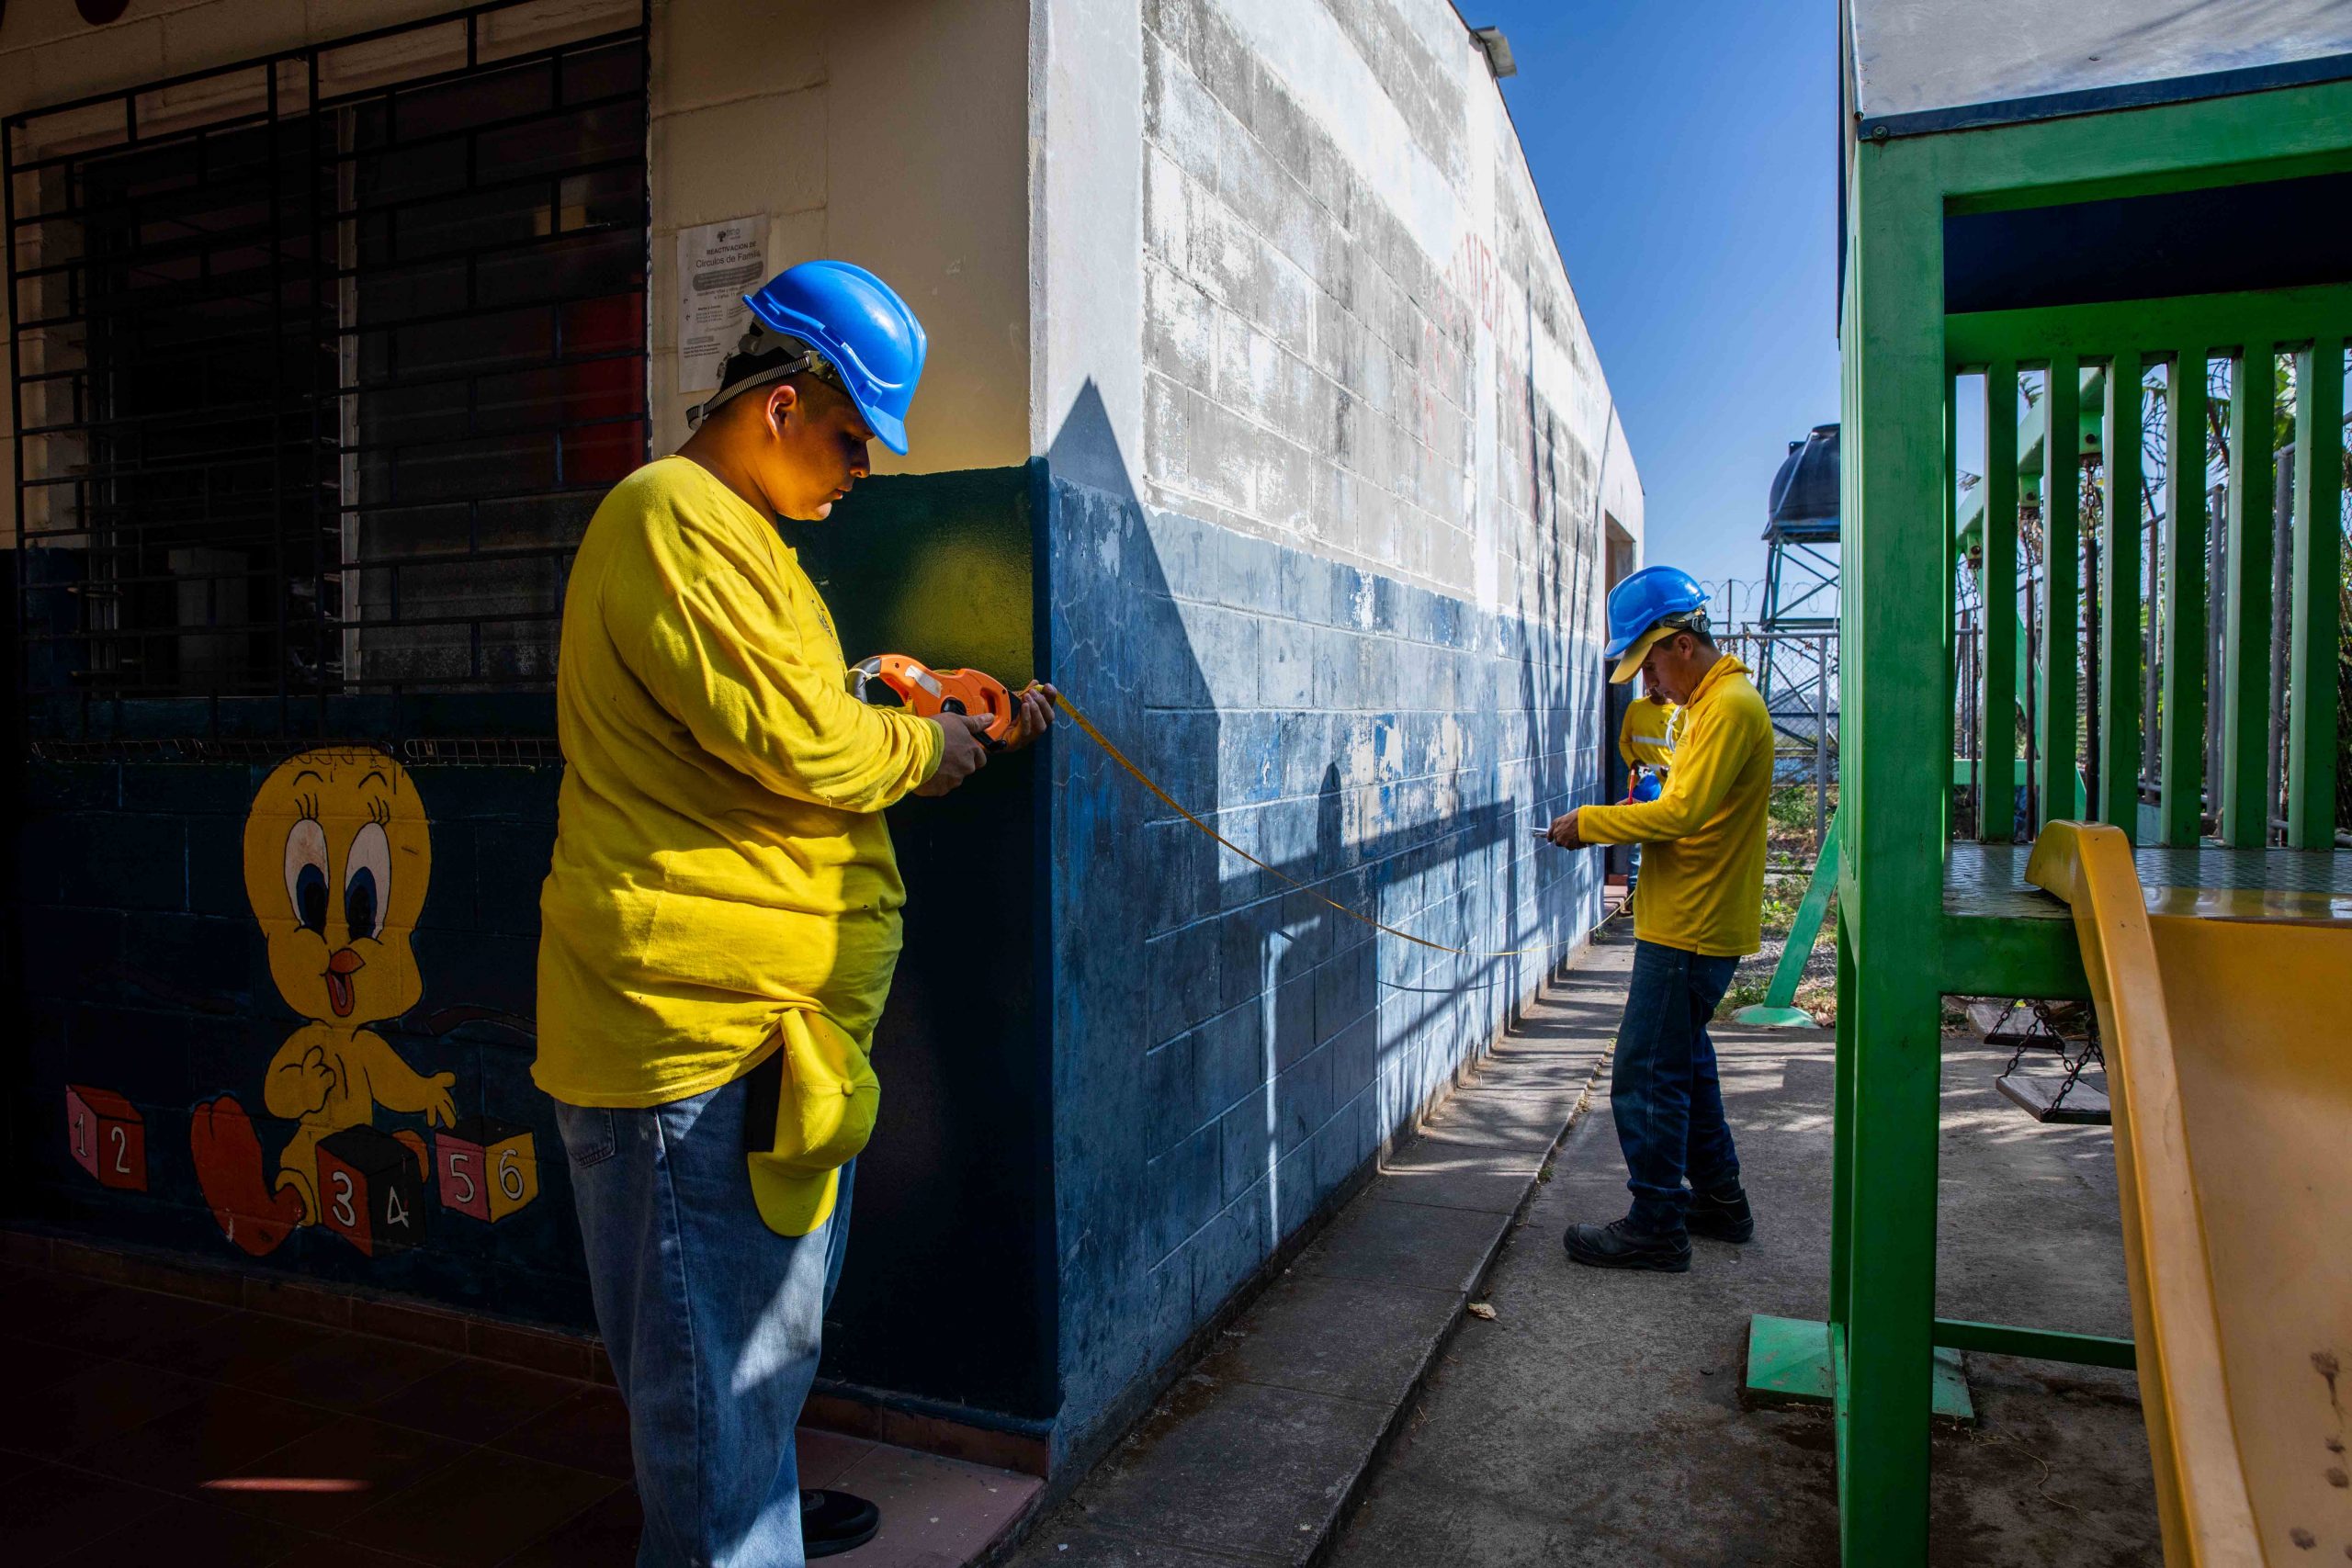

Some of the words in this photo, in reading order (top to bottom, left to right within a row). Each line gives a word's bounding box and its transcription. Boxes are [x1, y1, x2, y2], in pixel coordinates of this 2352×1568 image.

[726, 254, 736, 264] de
[74, 1112, 88, 1156] 1
[111, 1125, 130, 1174] 2
[449, 1154, 476, 1203] 5
[498, 1148, 525, 1200] 6
[331, 1170, 356, 1228] 3
[386, 1185, 410, 1229] 4
